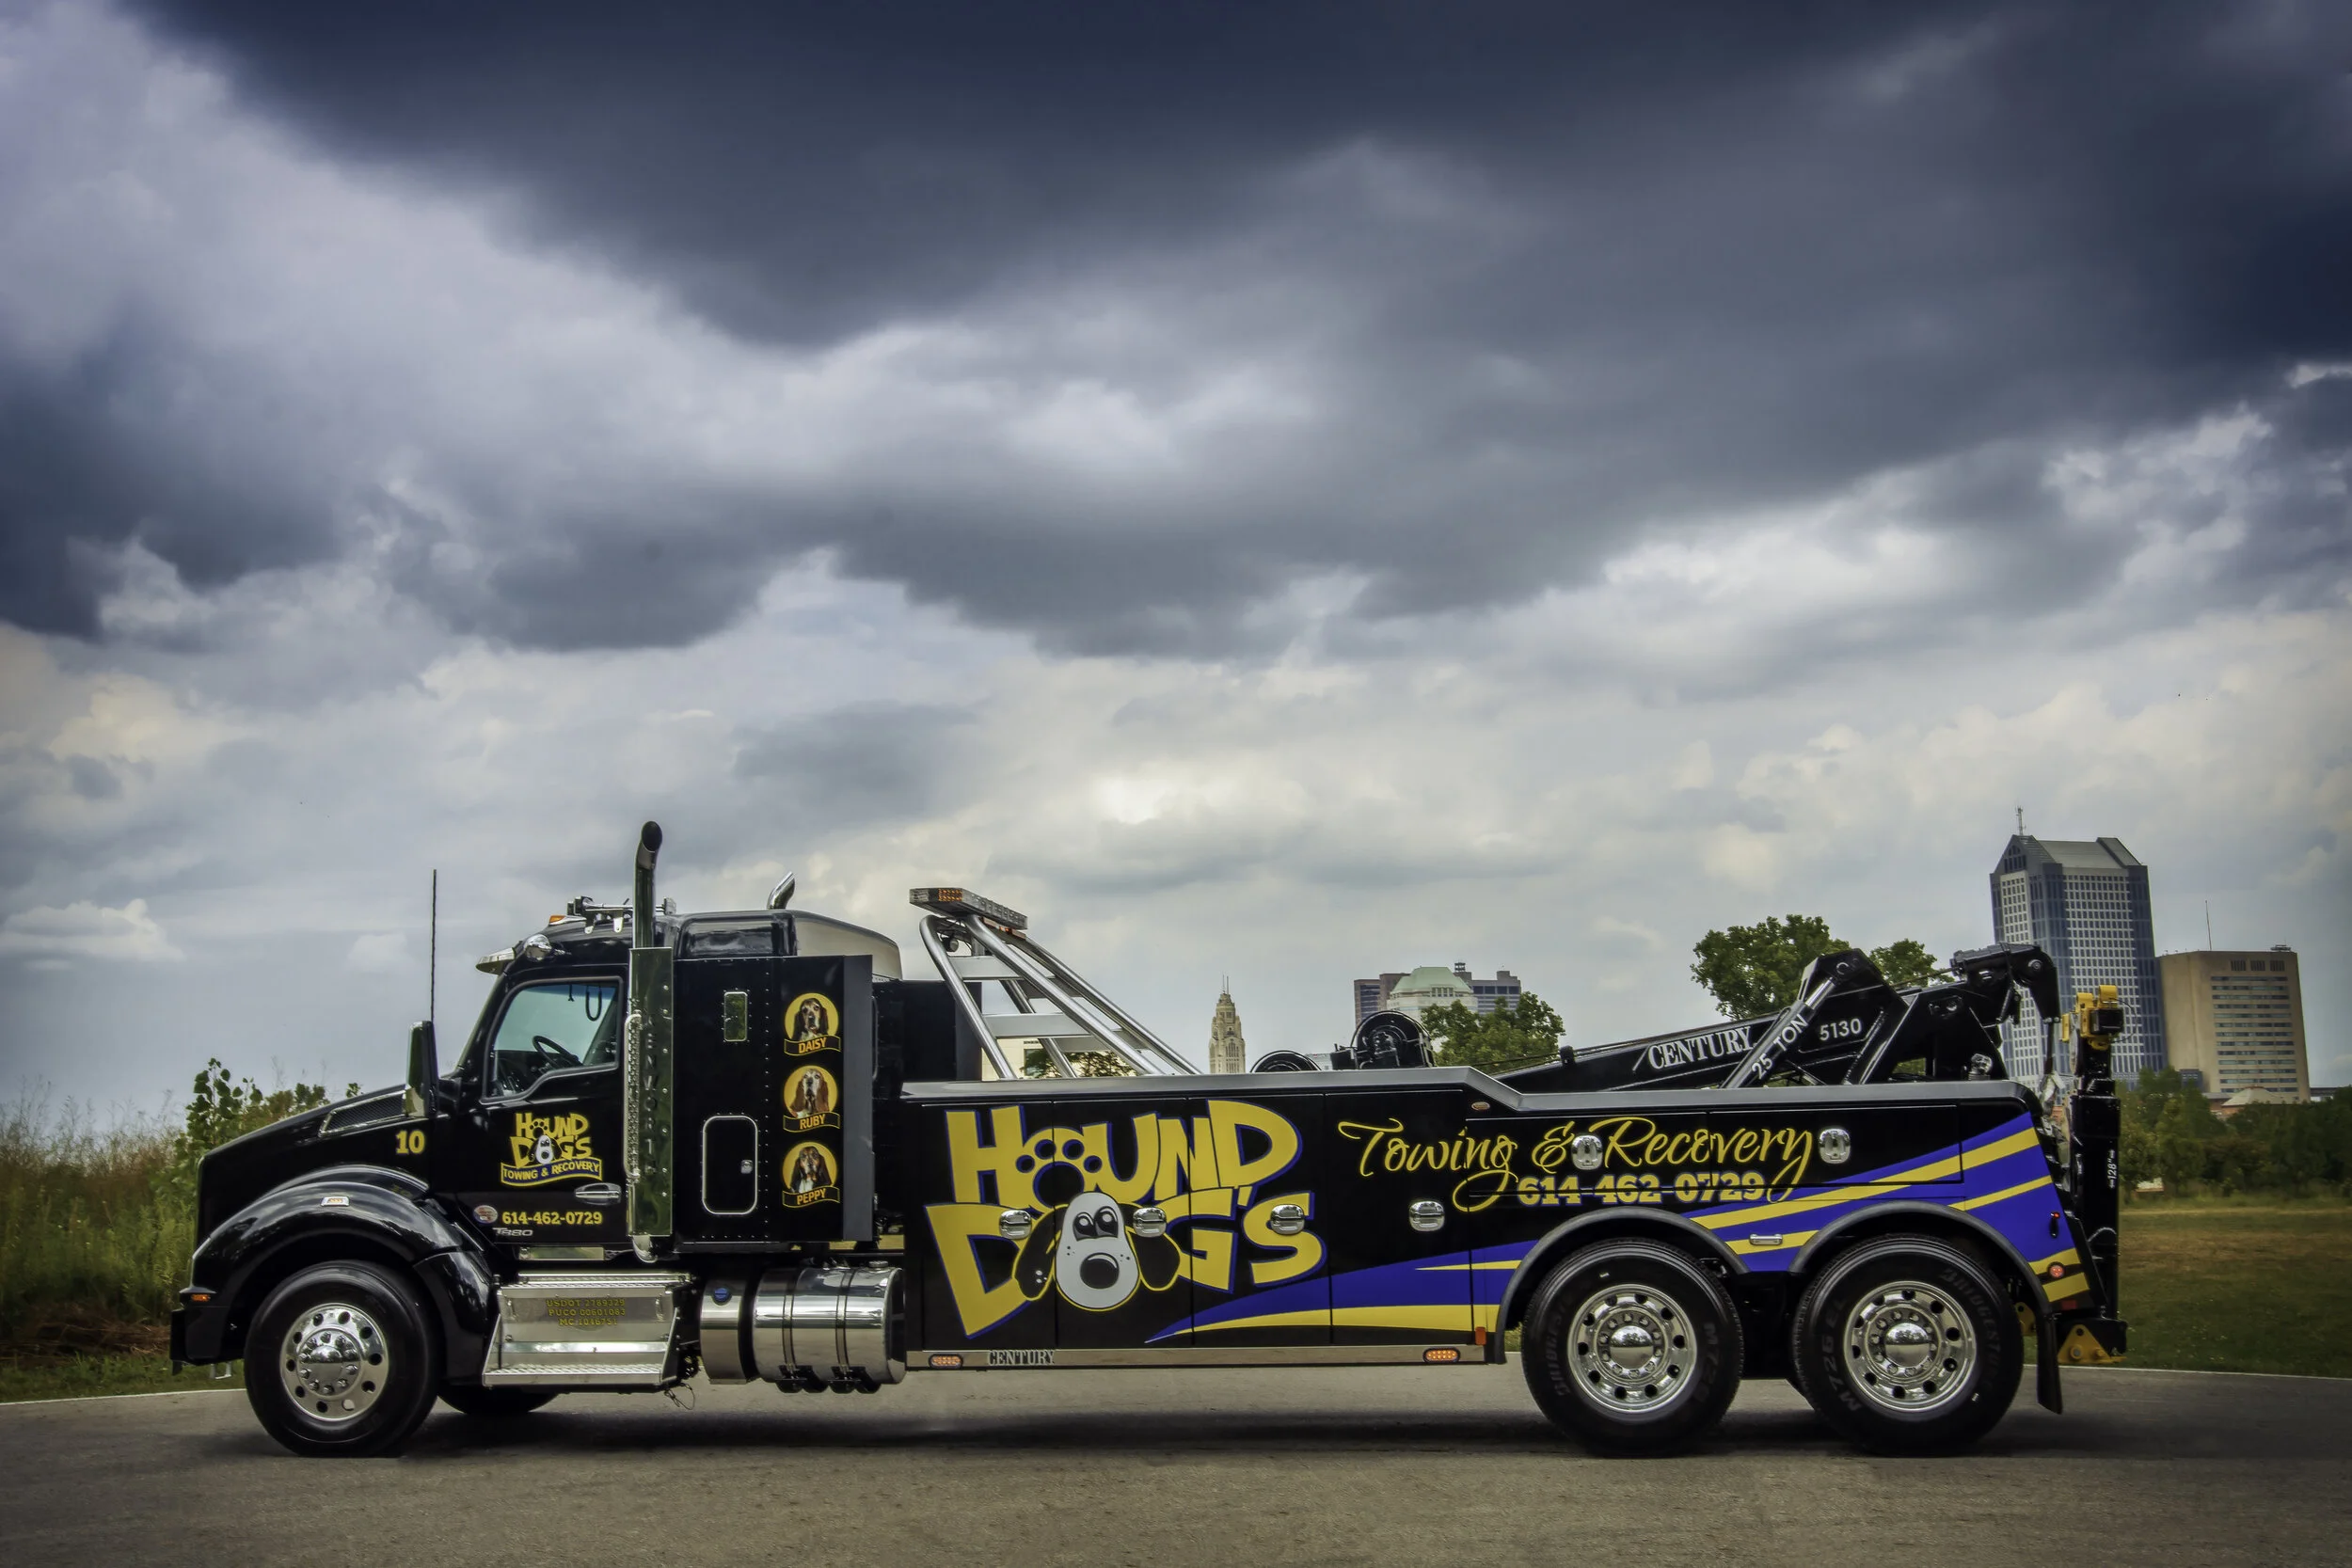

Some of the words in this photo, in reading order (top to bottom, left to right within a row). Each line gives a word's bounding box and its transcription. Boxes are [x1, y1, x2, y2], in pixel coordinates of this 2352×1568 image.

[1820, 1018, 1862, 1041] 5130
[799, 1037, 828, 1054] DAISY
[1648, 1025, 1754, 1069] CENTURY
[1751, 1053, 1773, 1080] 25
[1773, 1014, 1809, 1053] TON
[515, 1112, 590, 1141] HOUND
[799, 1114, 826, 1130] RUBY
[396, 1130, 425, 1154] 10
[945, 1099, 1302, 1213] HOUND
[1337, 1117, 1519, 1213] Towing
[1532, 1120, 1577, 1174] &
[1582, 1117, 1813, 1204] Recovery
[502, 1168, 539, 1180] TOWING
[541, 1167, 549, 1177] &
[551, 1160, 600, 1175] RECOVERY
[796, 1187, 827, 1206] PEPPY
[1517, 1172, 1766, 1207] 614-462-0729
[501, 1211, 603, 1225] 614-462-0729
[492, 1227, 533, 1236] T880
[546, 1299, 581, 1307] USDOT
[548, 1308, 577, 1317] PUCO
[559, 1318, 575, 1326] MC
[988, 1349, 1055, 1367] CENTURY
